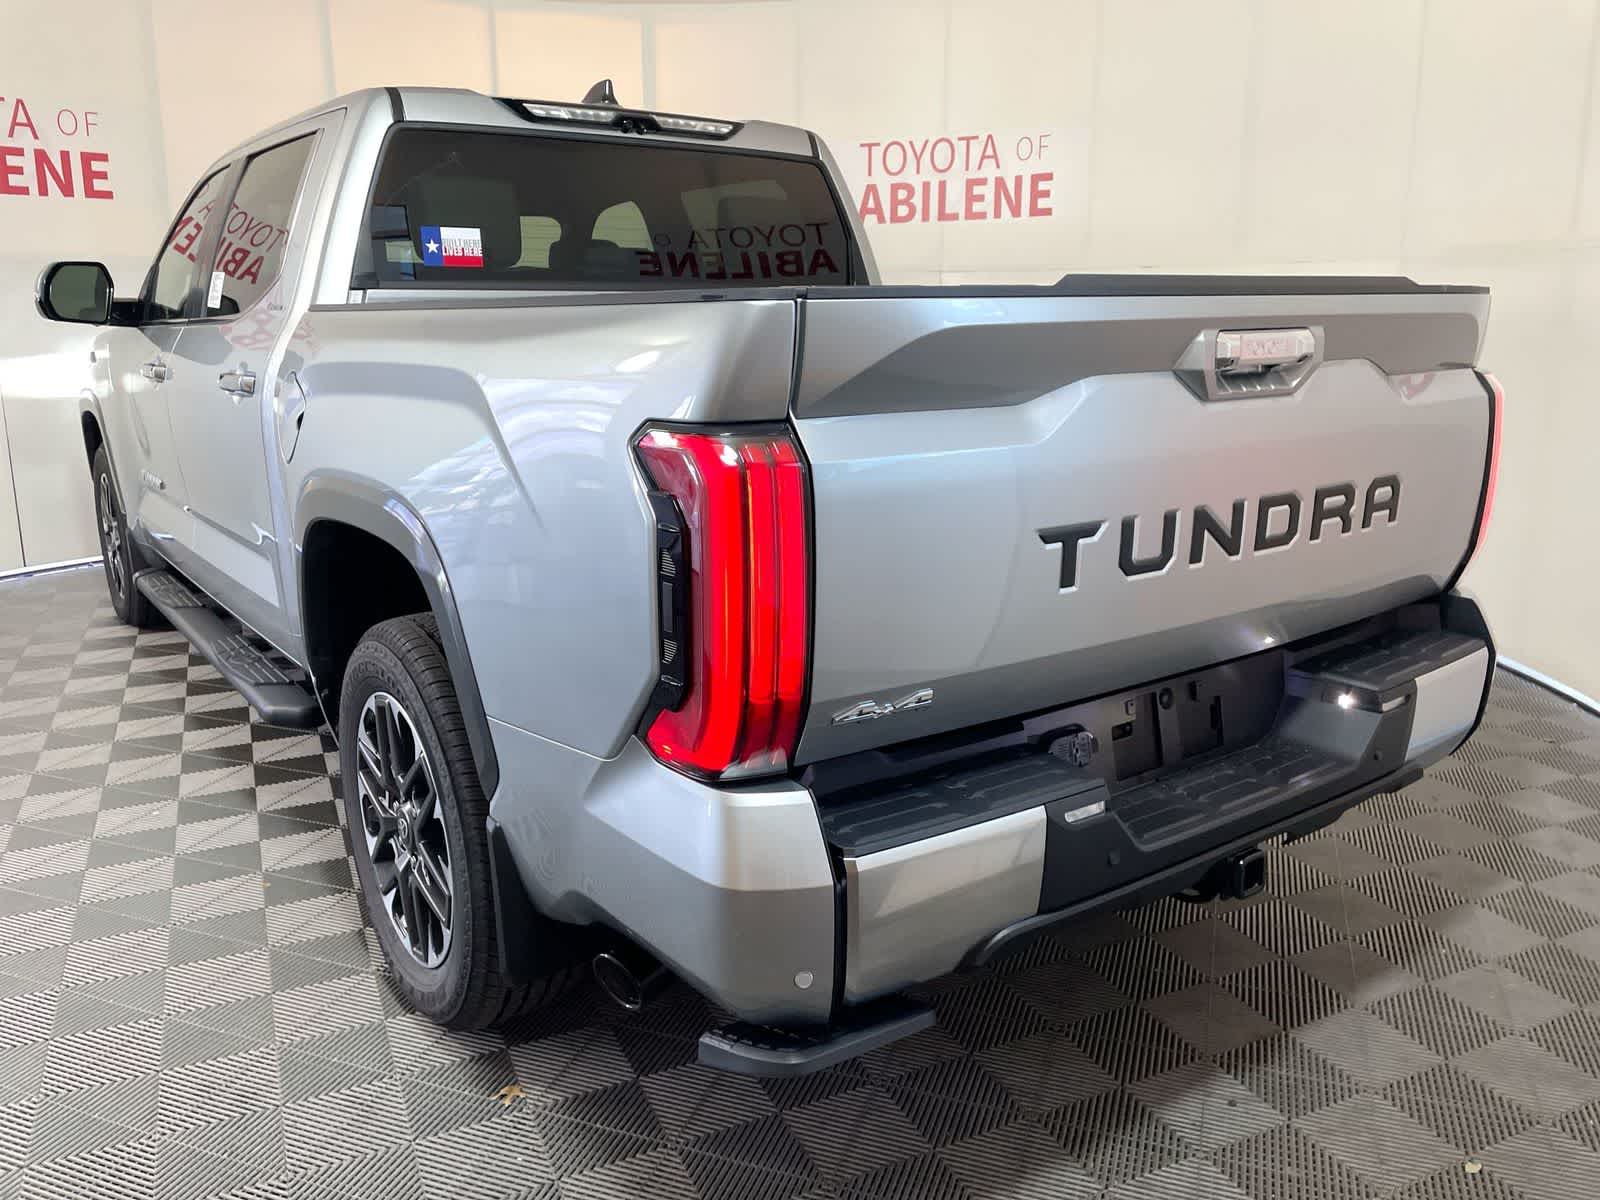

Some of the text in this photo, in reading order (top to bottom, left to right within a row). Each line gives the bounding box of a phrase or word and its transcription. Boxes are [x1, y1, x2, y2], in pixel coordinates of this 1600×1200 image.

[0, 97, 98, 140] A OF
[859, 134, 1051, 177] TOYOTA OF
[859, 172, 1054, 225] ABILENE
[443, 247, 483, 256] LIVES HERE
[1036, 474, 1402, 594] TUNDRA
